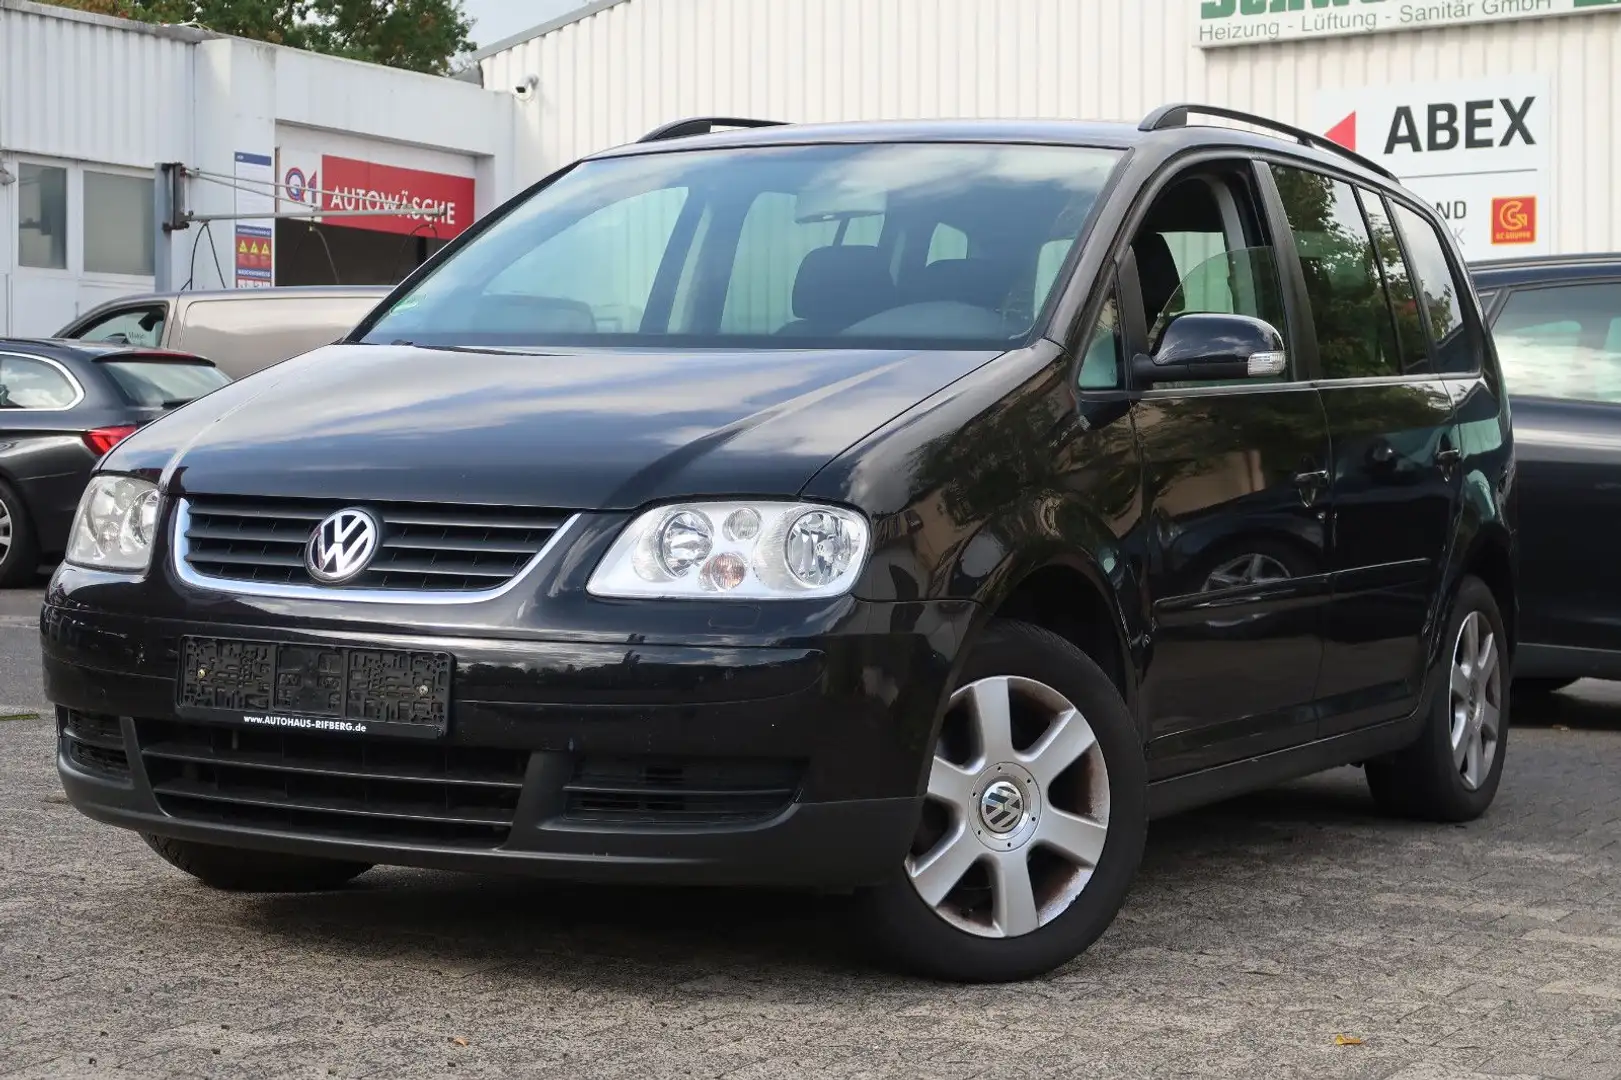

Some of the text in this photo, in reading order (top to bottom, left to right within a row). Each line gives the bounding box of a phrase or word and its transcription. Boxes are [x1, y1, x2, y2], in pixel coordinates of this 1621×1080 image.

[1199, 22, 1280, 41] Heizung
[1301, 12, 1377, 32] Lüftung
[1399, 2, 1474, 23] Sanitär
[1384, 96, 1536, 154] ABEX
[330, 185, 456, 224] AUTOWÄSCHE
[1436, 200, 1467, 220] ND
[305, 508, 378, 582] VW
[243, 716, 367, 732] www.AUTOHAUS-RIFBERG.de
